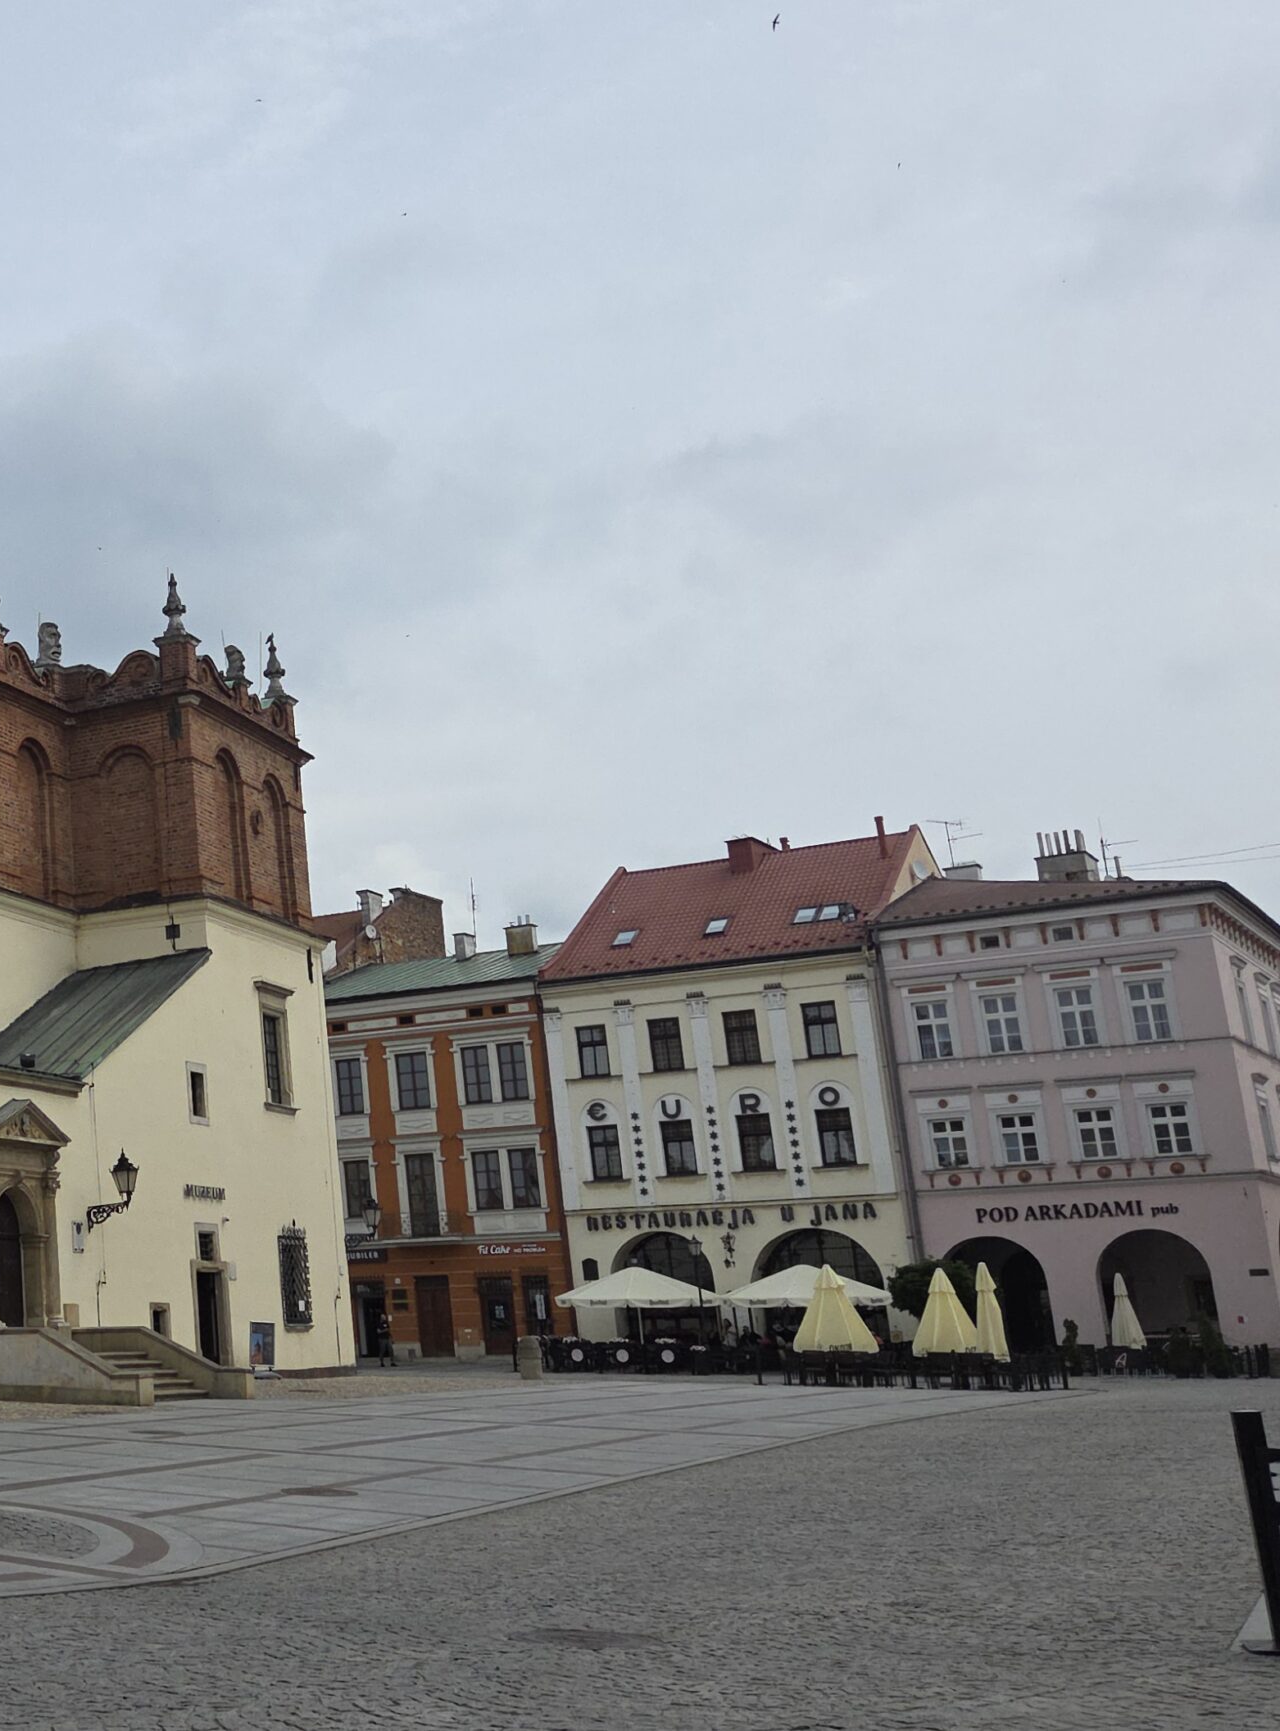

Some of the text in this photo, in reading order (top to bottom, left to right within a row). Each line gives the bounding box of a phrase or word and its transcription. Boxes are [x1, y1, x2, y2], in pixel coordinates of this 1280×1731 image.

[184, 1184, 226, 1200] MUZEUM
[586, 1202, 877, 1231] RESTAURACJA U JANA
[976, 1200, 1179, 1223] POD ARKADAMI pub
[490, 1244, 510, 1254] Cake
